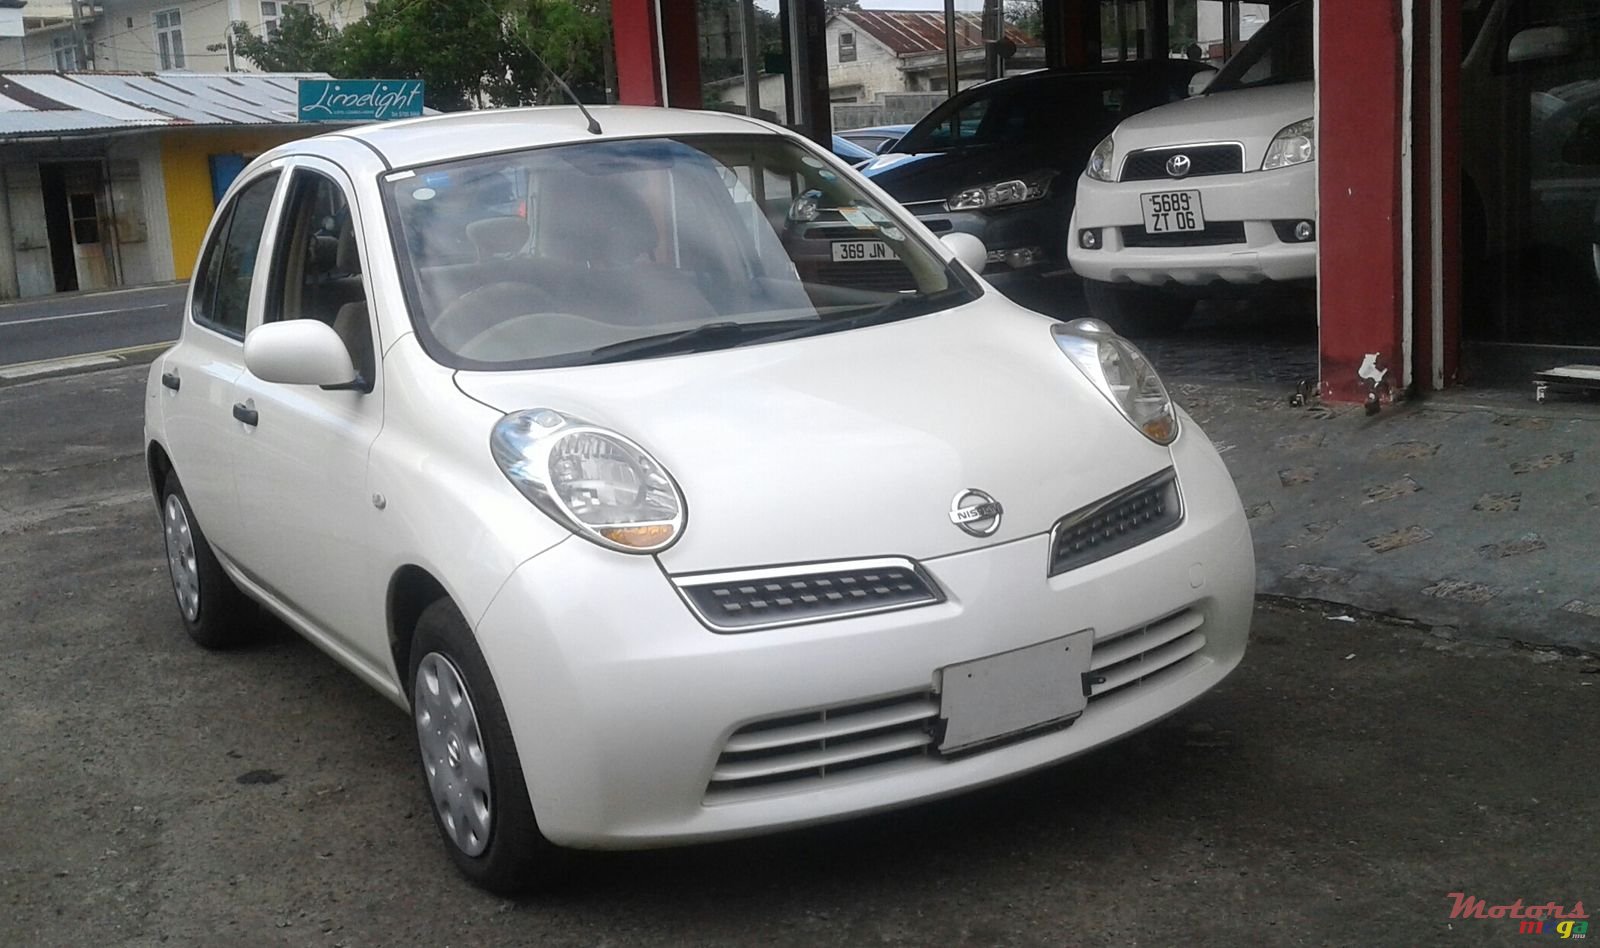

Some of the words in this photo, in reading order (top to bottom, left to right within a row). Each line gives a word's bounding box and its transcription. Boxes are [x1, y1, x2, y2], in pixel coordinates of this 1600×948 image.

[302, 82, 421, 118] Limelight
[1151, 193, 1190, 212] 5689
[1152, 212, 1169, 231] ZT
[1176, 211, 1195, 230] 06
[840, 243, 864, 259] 369
[870, 243, 885, 258] JN
